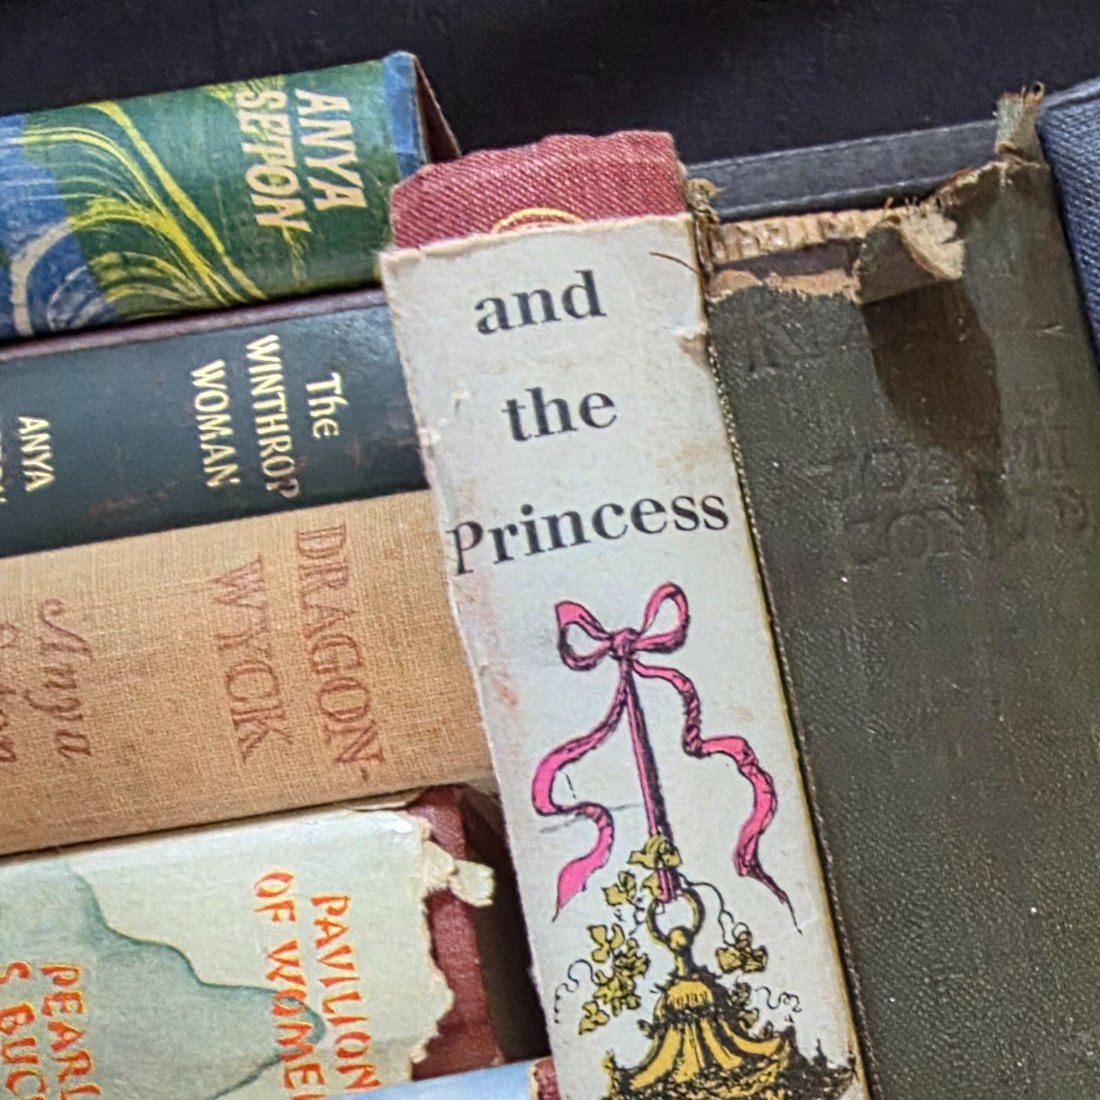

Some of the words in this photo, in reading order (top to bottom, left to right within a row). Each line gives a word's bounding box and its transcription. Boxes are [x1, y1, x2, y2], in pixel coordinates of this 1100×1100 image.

[235, 88, 310, 233] SETON
[295, 87, 367, 210] ANYA
[473, 269, 606, 336] and
[18, 415, 55, 492] ANYA
[190, 360, 241, 488] WOMAN
[244, 334, 300, 499] WINTHROP
[306, 371, 349, 438] The
[504, 387, 618, 442] the
[446, 491, 729, 575] Princess
[210, 550, 292, 765] WYCK
[254, 871, 297, 923] OF
[310, 892, 382, 1090] PAVILION
